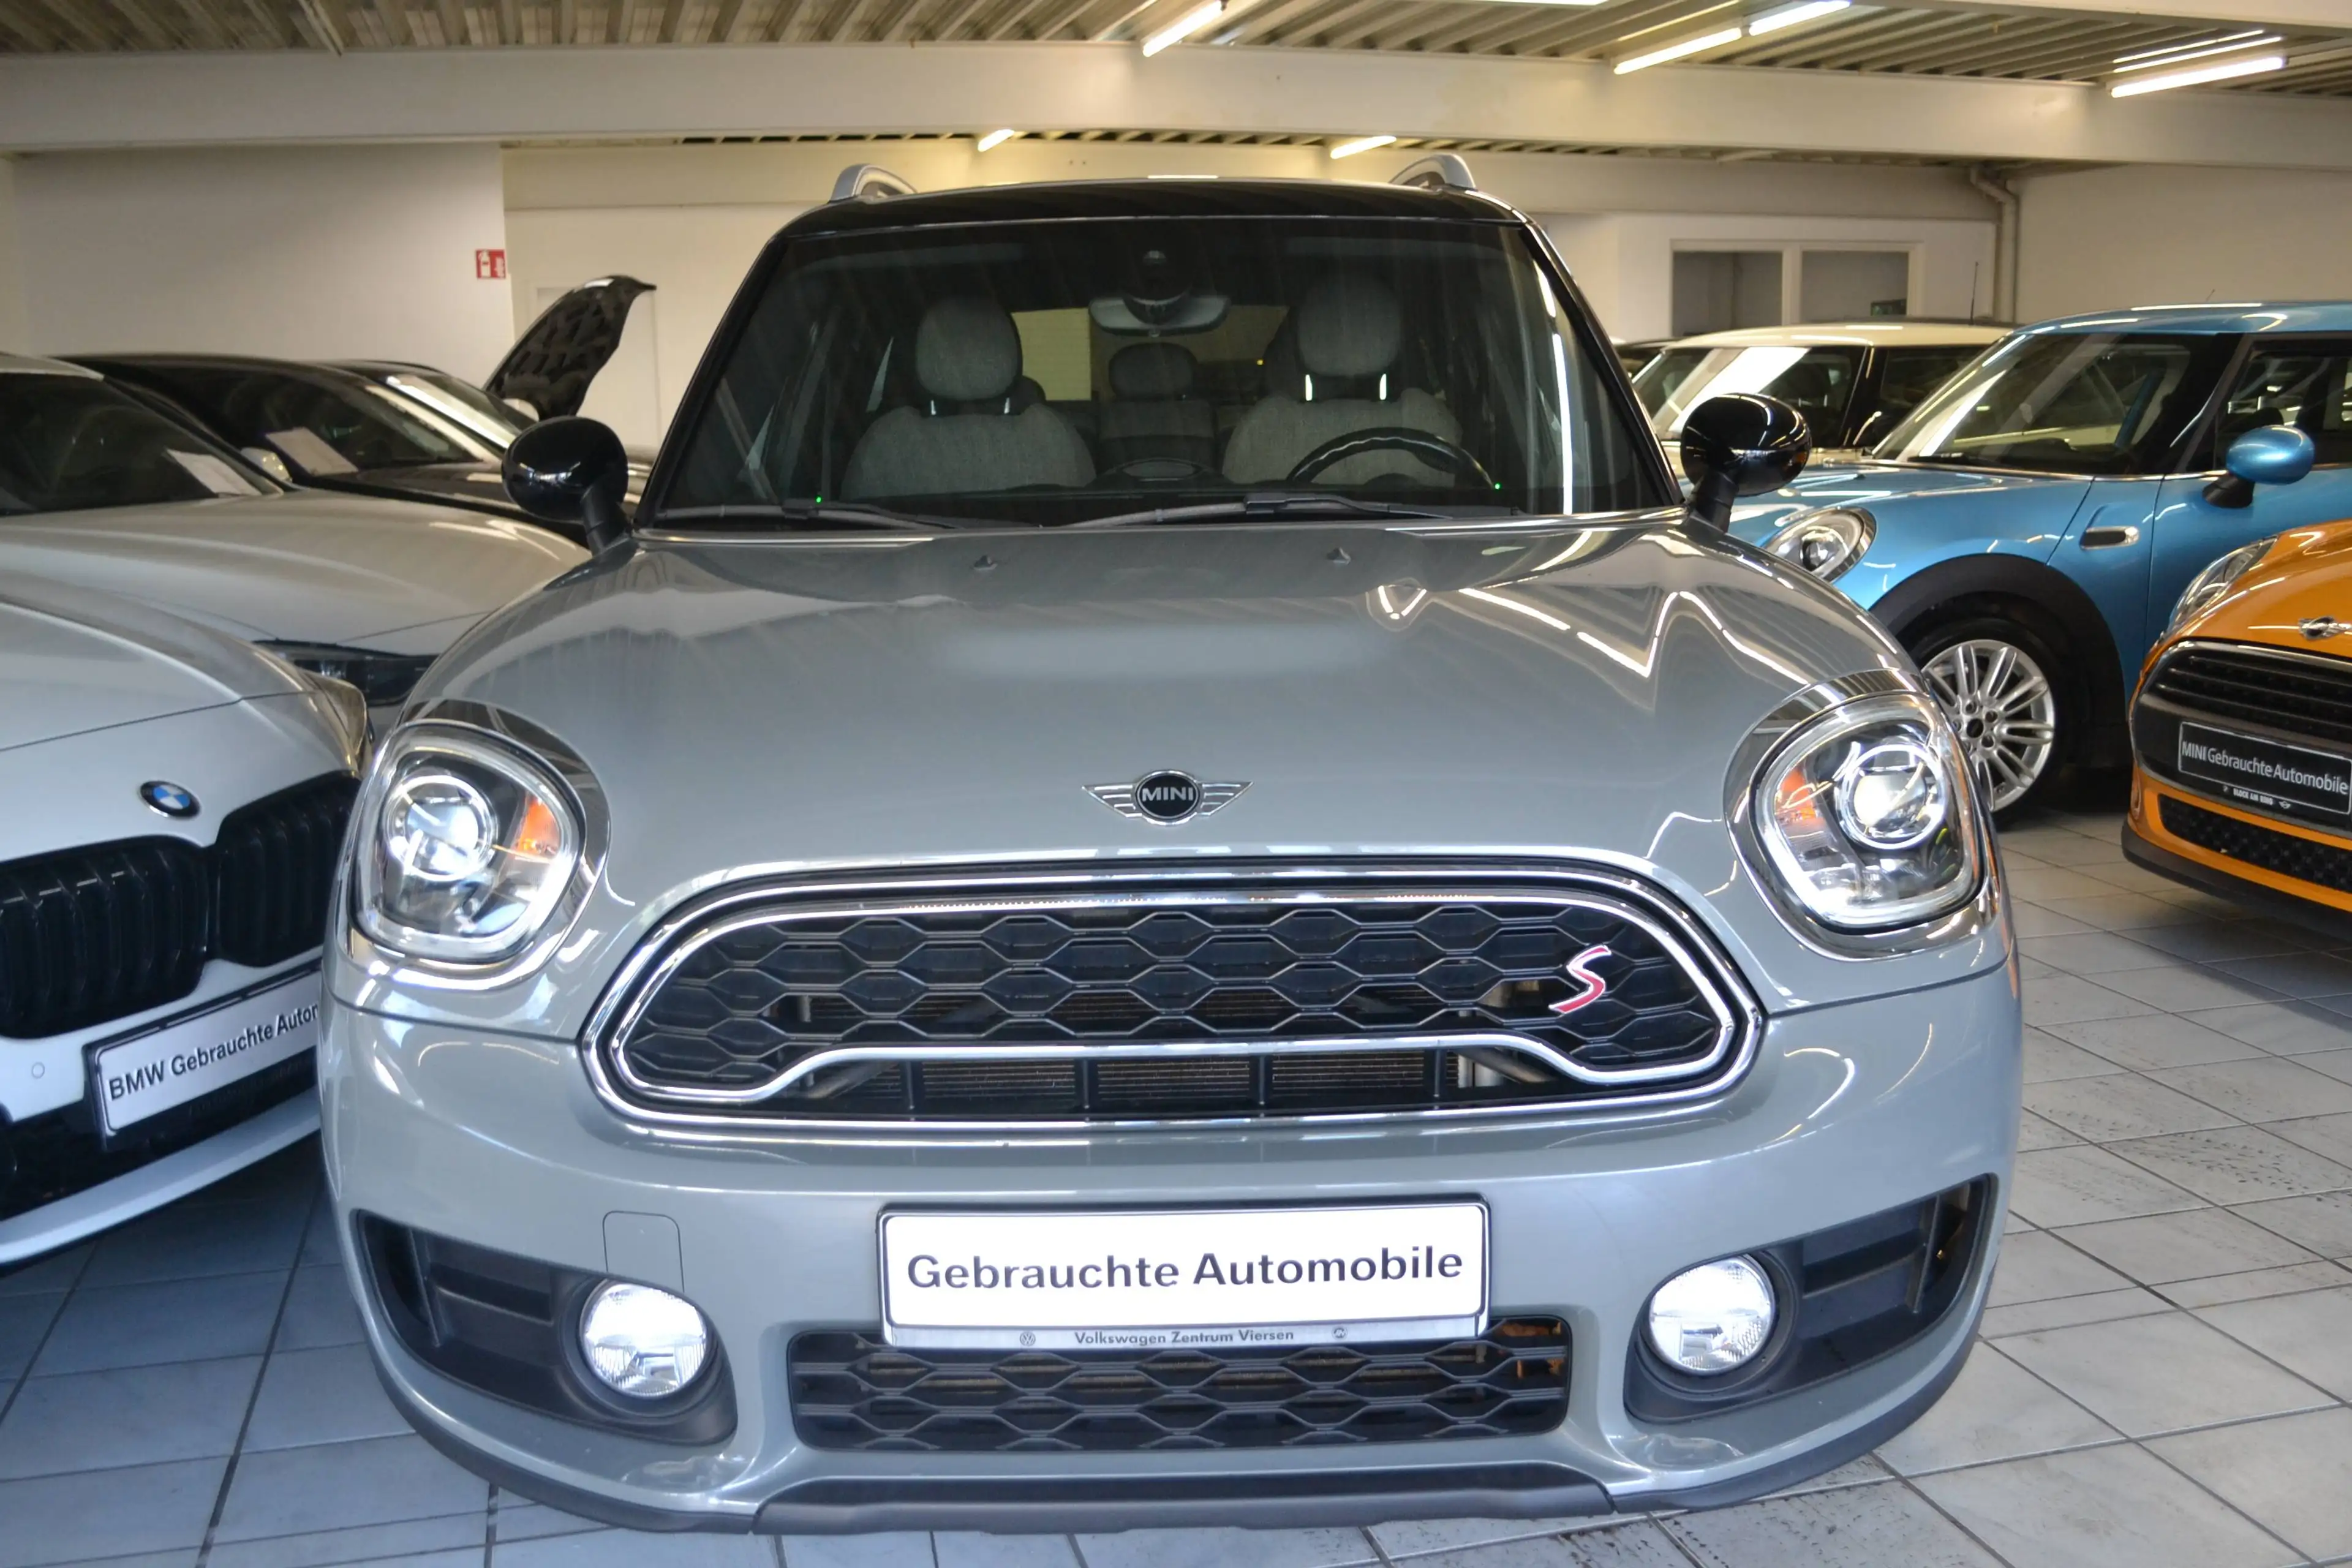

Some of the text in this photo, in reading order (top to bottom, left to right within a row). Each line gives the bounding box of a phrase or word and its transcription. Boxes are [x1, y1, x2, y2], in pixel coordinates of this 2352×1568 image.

[2182, 740, 2349, 795] MINI Gebrauchte Automobile
[1142, 786, 1193, 801] MINI
[109, 1060, 164, 1101] BMW
[171, 1023, 274, 1076] Gebrauchte
[908, 1245, 1463, 1289] Gebrauchte Automobile
[1075, 1331, 1166, 1346] Volkswagen
[1171, 1331, 1233, 1343] Zentrum
[1238, 1329, 1294, 1342] Viersen
